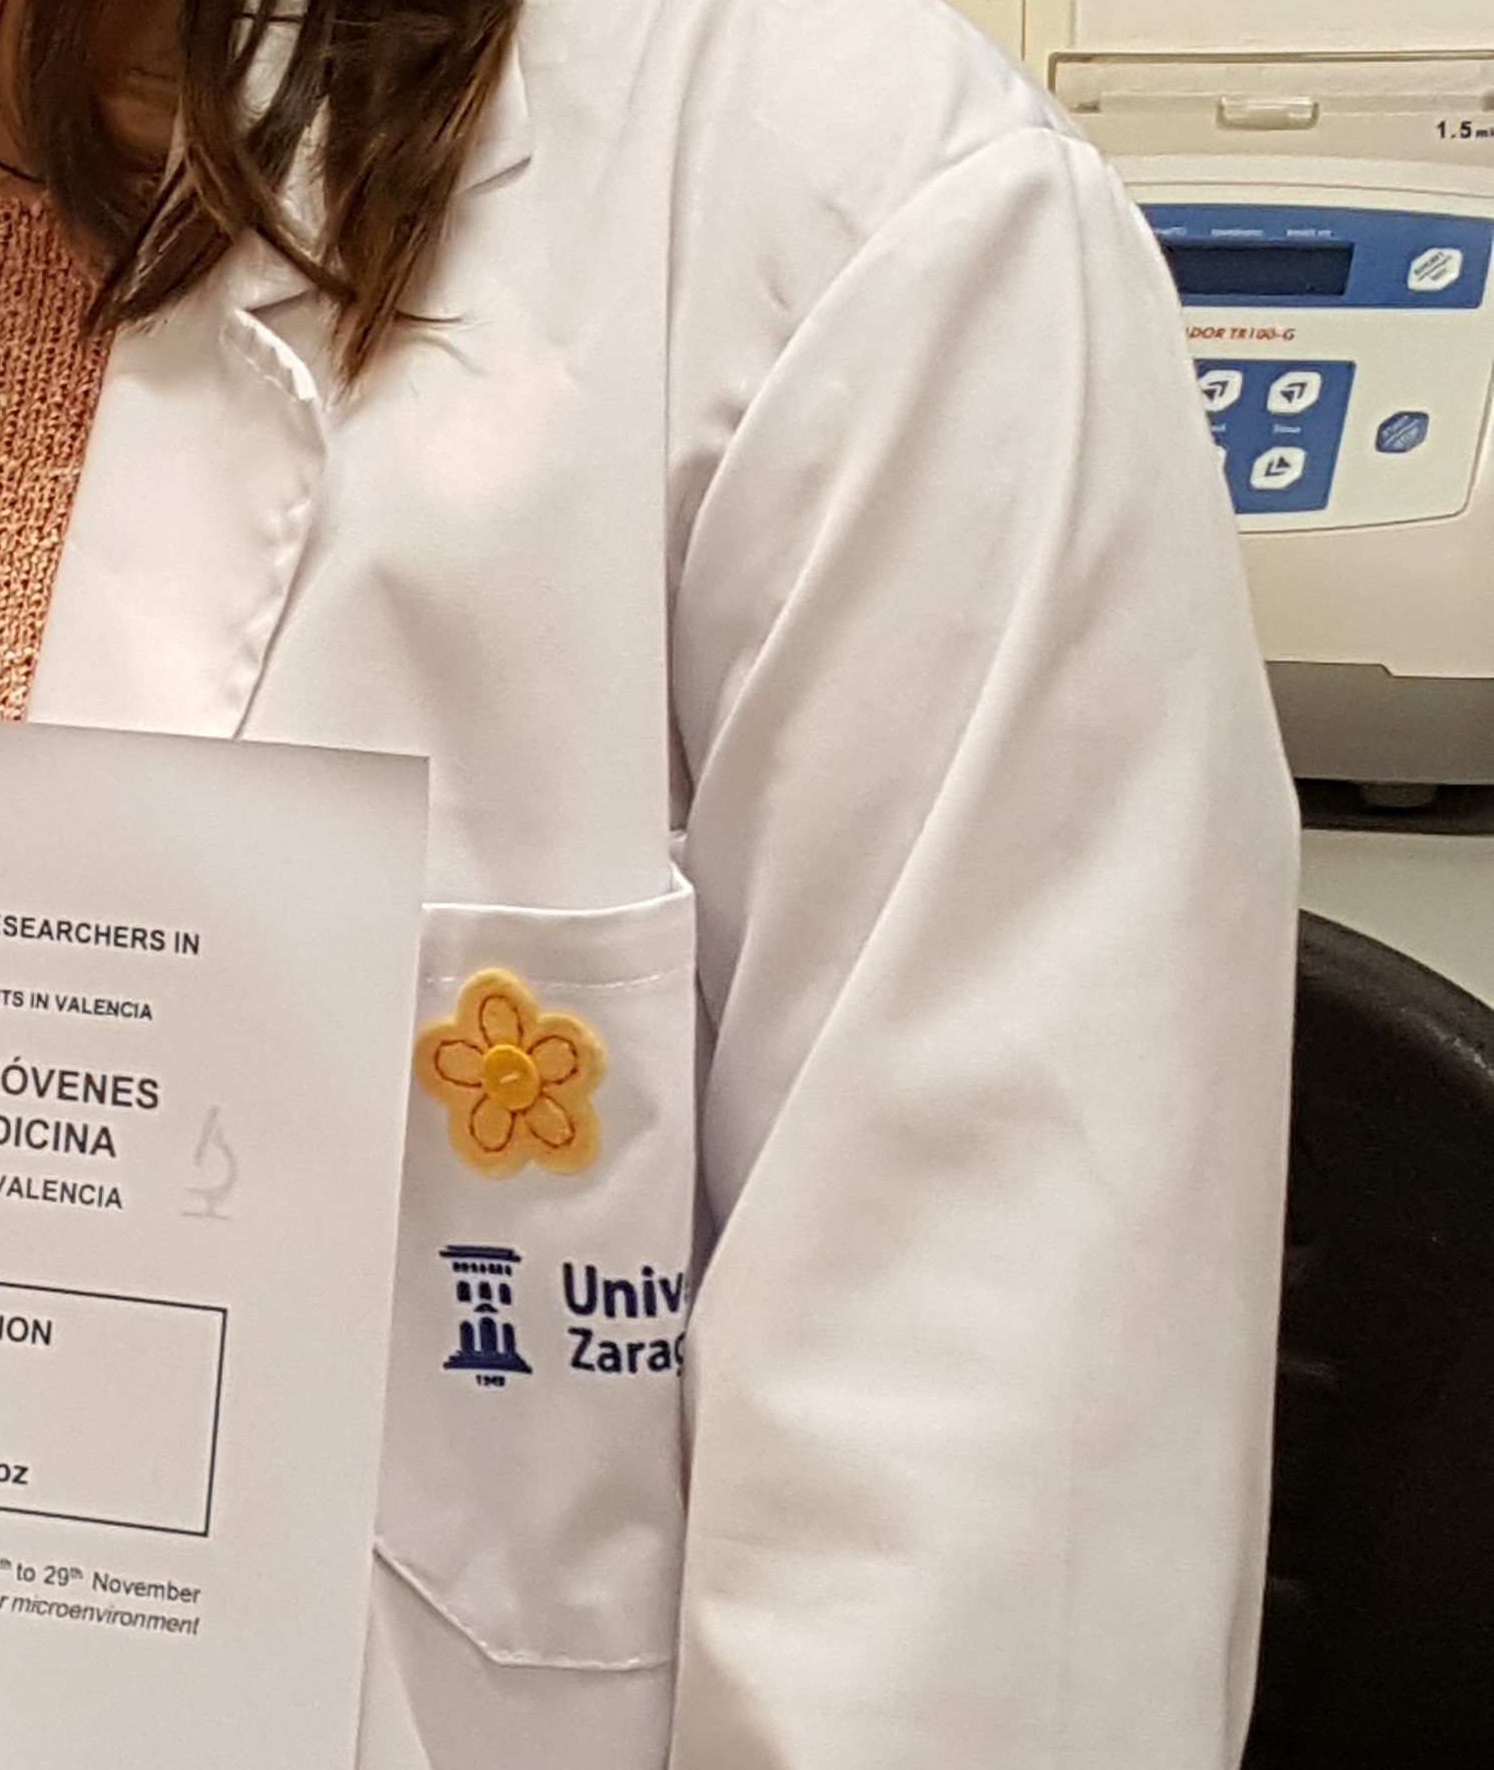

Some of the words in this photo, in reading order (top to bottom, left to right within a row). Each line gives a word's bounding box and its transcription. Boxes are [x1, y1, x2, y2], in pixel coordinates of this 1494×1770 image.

[1436, 120, 1472, 140] 1.5
[174, 930, 199, 955] IN
[29, 992, 49, 1010] IN
[54, 994, 153, 1020] VALENCIA
[562, 1262, 683, 1318] Univ
[15, 1562, 36, 1582] to
[91, 1570, 201, 1603] November
[10, 1596, 200, 1635] microenvironment
